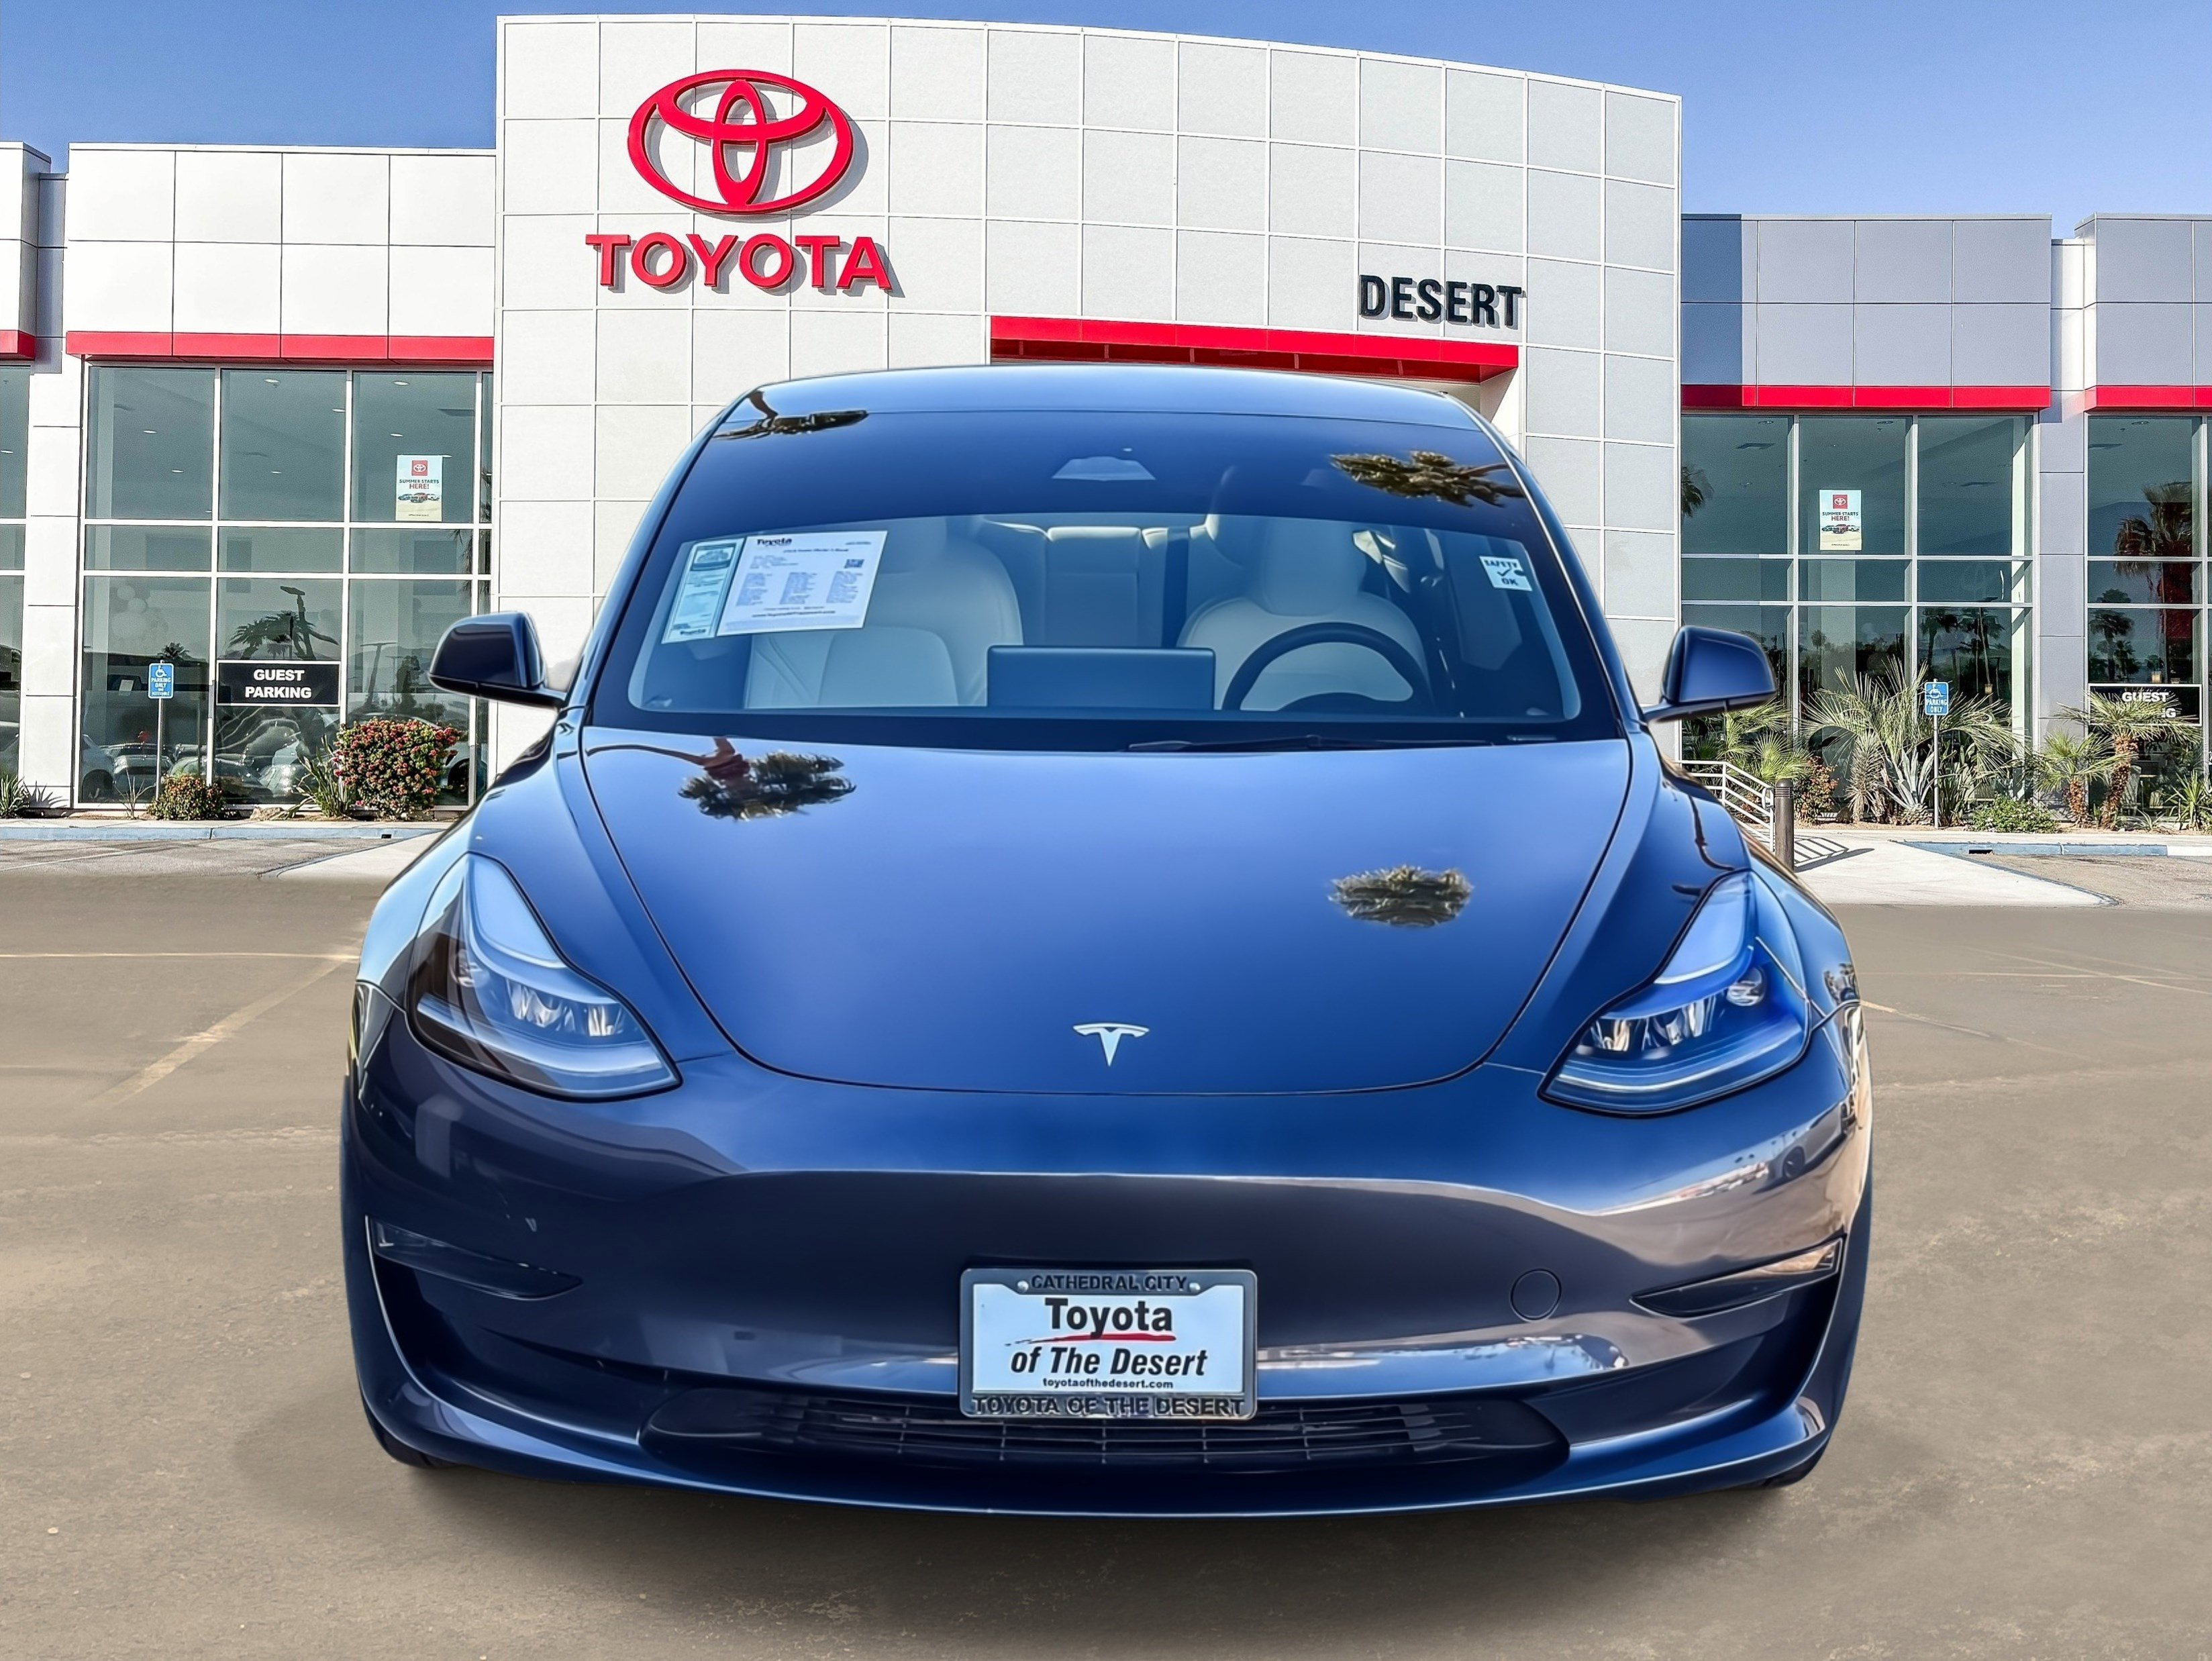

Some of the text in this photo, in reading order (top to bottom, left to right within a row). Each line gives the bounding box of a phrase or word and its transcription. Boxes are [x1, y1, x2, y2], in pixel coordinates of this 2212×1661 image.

[585, 232, 893, 290] TOYOTA
[1359, 274, 1522, 327] DESERT
[253, 669, 305, 681] GUEST
[245, 687, 312, 699] PARKING
[2121, 691, 2170, 703] GUEST
[1032, 1275, 1187, 1291] CATHEDRAL CITY
[1044, 1297, 1173, 1339] Toyota
[1010, 1346, 1208, 1376] of The Desert
[1042, 1378, 1174, 1389] toyotaofthedesert.com
[972, 1397, 1245, 1416] TOYOTA OF THE DESERT
